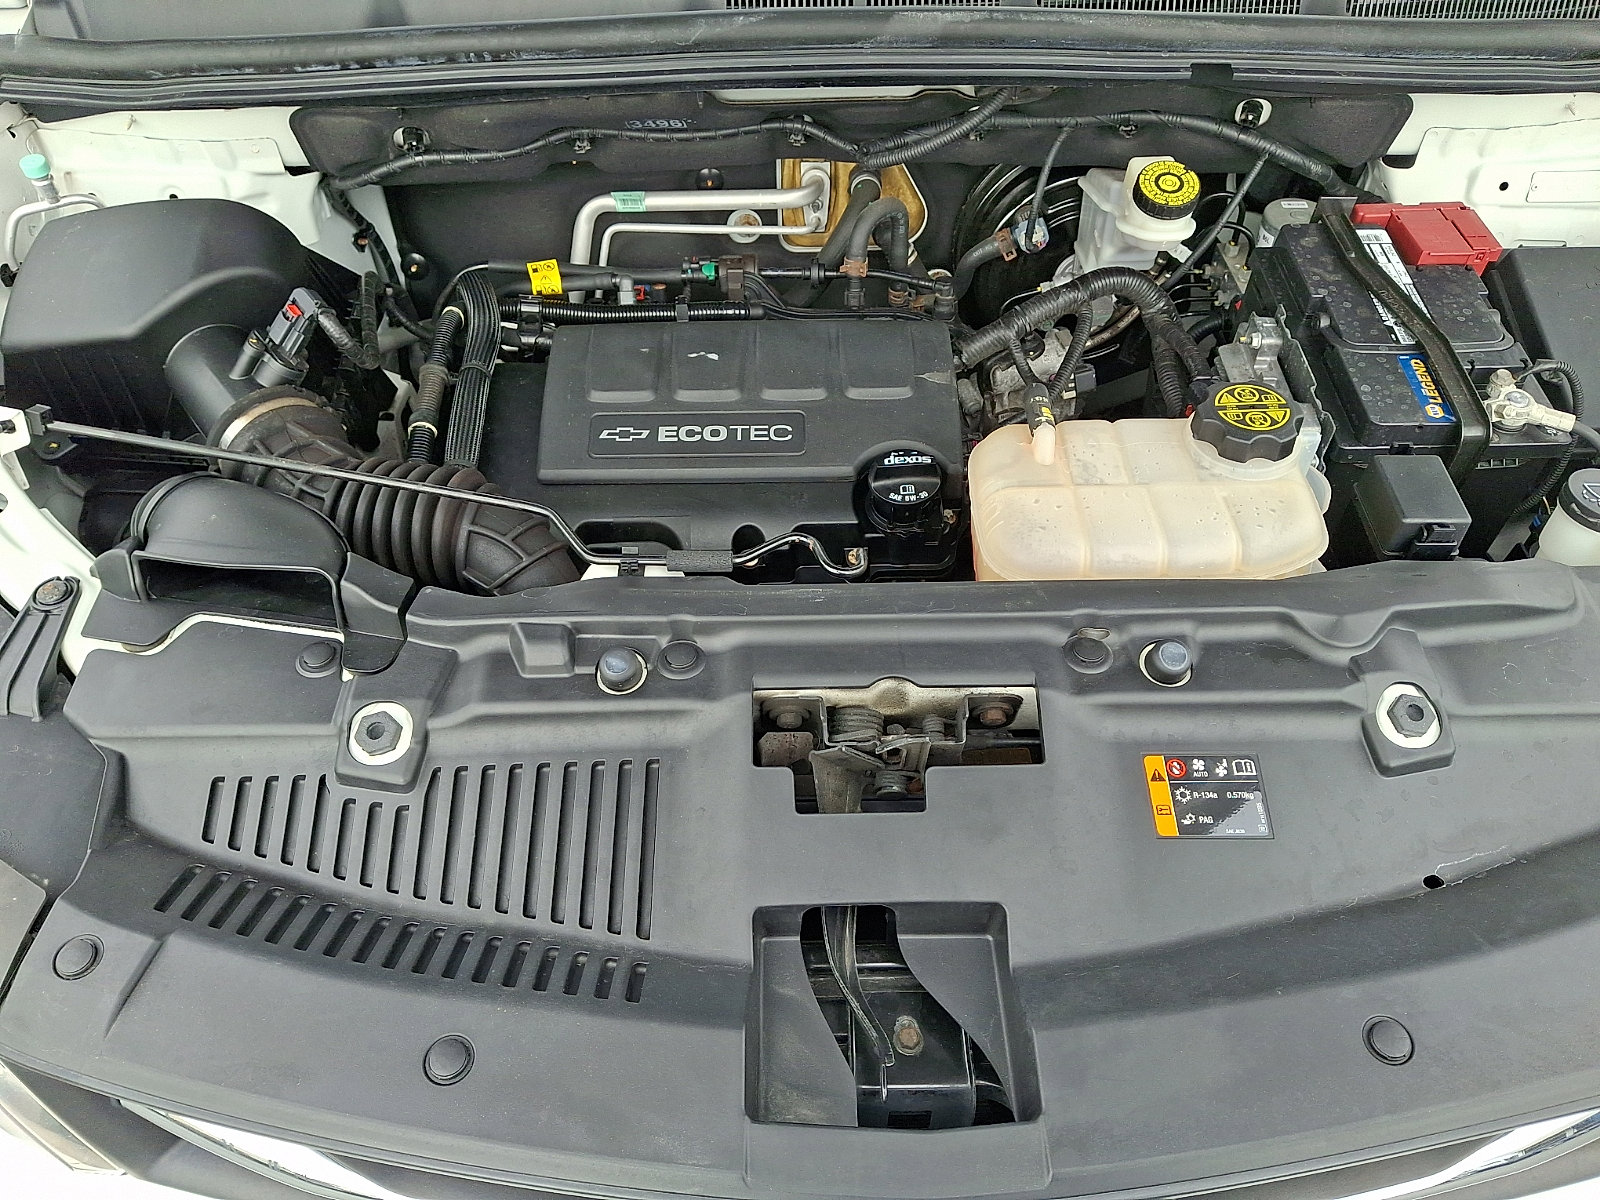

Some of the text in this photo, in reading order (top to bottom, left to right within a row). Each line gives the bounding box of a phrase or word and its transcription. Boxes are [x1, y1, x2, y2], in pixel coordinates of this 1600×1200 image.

[1410, 359, 1443, 404] LEGEND
[657, 424, 793, 442] ECOTEC
[884, 452, 934, 465] dexos
[1193, 791, 1255, 800] R-134a 0.570kg
[1198, 816, 1214, 824] PAG
